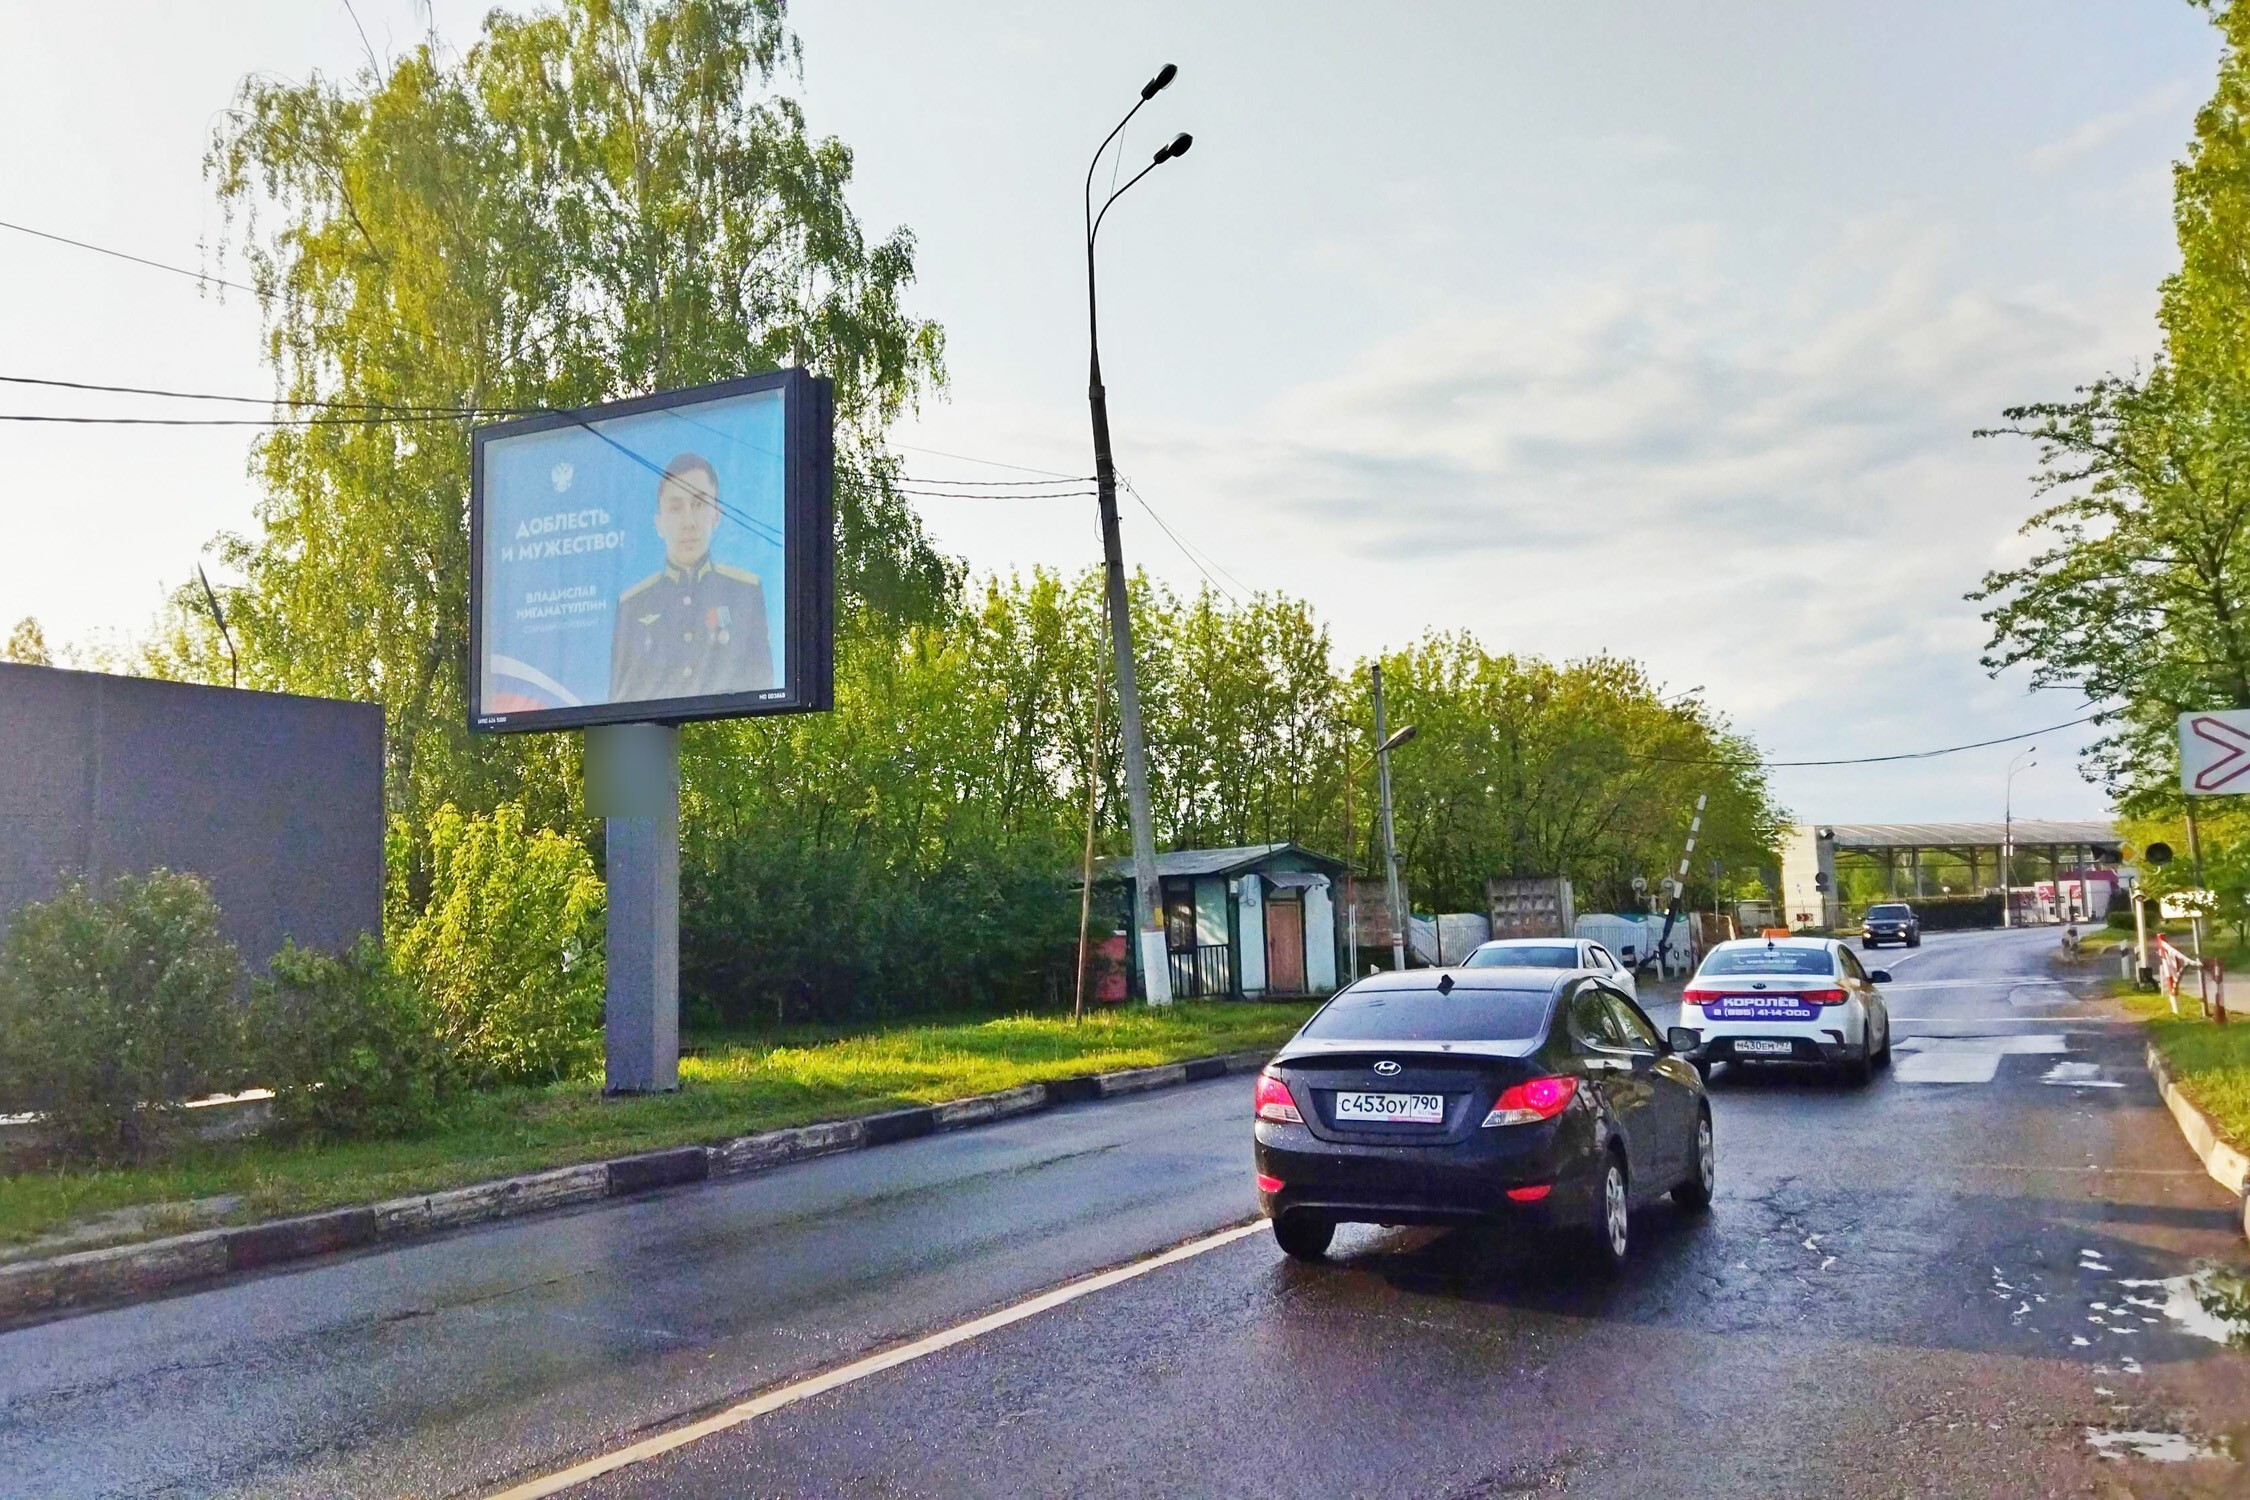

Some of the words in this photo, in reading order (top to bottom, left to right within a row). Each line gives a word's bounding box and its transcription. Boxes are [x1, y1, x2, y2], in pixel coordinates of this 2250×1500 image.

[515, 508, 609, 540] ДОБЛЕСТЬ
[502, 546, 514, 562] И
[519, 530, 625, 560] МУЖЕСТВО!
[526, 585, 597, 604] ВЛАДИСЛАВ
[516, 600, 607, 619] НИГАМАТУЛЛИН
[1723, 997, 1799, 1007] КОРОЛЁВ
[1757, 1009, 1811, 1017] 41-14-000
